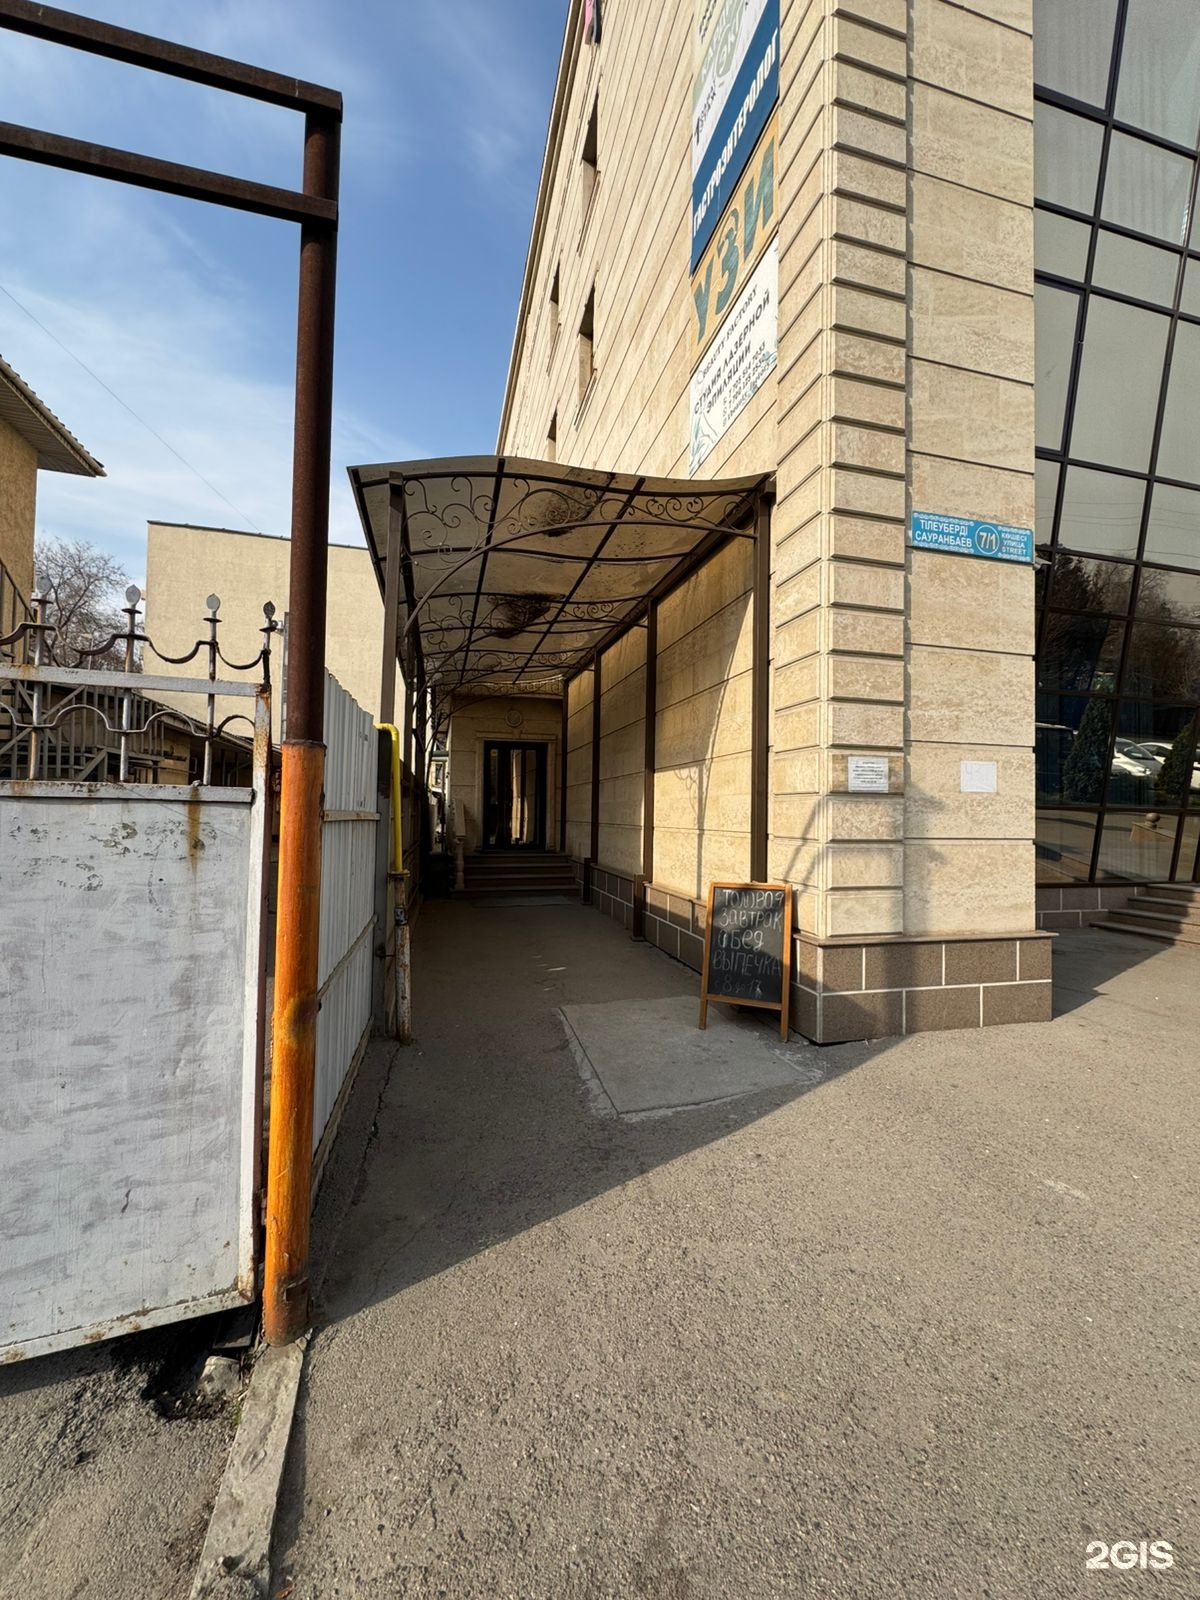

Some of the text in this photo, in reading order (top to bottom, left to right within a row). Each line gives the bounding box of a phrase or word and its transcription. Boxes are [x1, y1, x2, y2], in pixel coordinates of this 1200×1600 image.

[693, 27, 778, 237] ГАСТРОЭНТЕРОЛОГ
[694, 135, 774, 345] УЗИ
[694, 366, 721, 414] СТУДИЯ
[723, 288, 771, 372] ЛАЗЕРНОЙ
[706, 340, 751, 413] ЭПИЛЯЦИИ
[915, 531, 972, 547] САУРАНБАЕВ
[920, 520, 968, 536] ТІЛЕУБЕРДІ
[980, 532, 996, 550] 7/1
[1002, 546, 1027, 555] STREET
[1003, 540, 1025, 548] УЛИЦА
[713, 949, 781, 977] ВЫПЕЧКА
